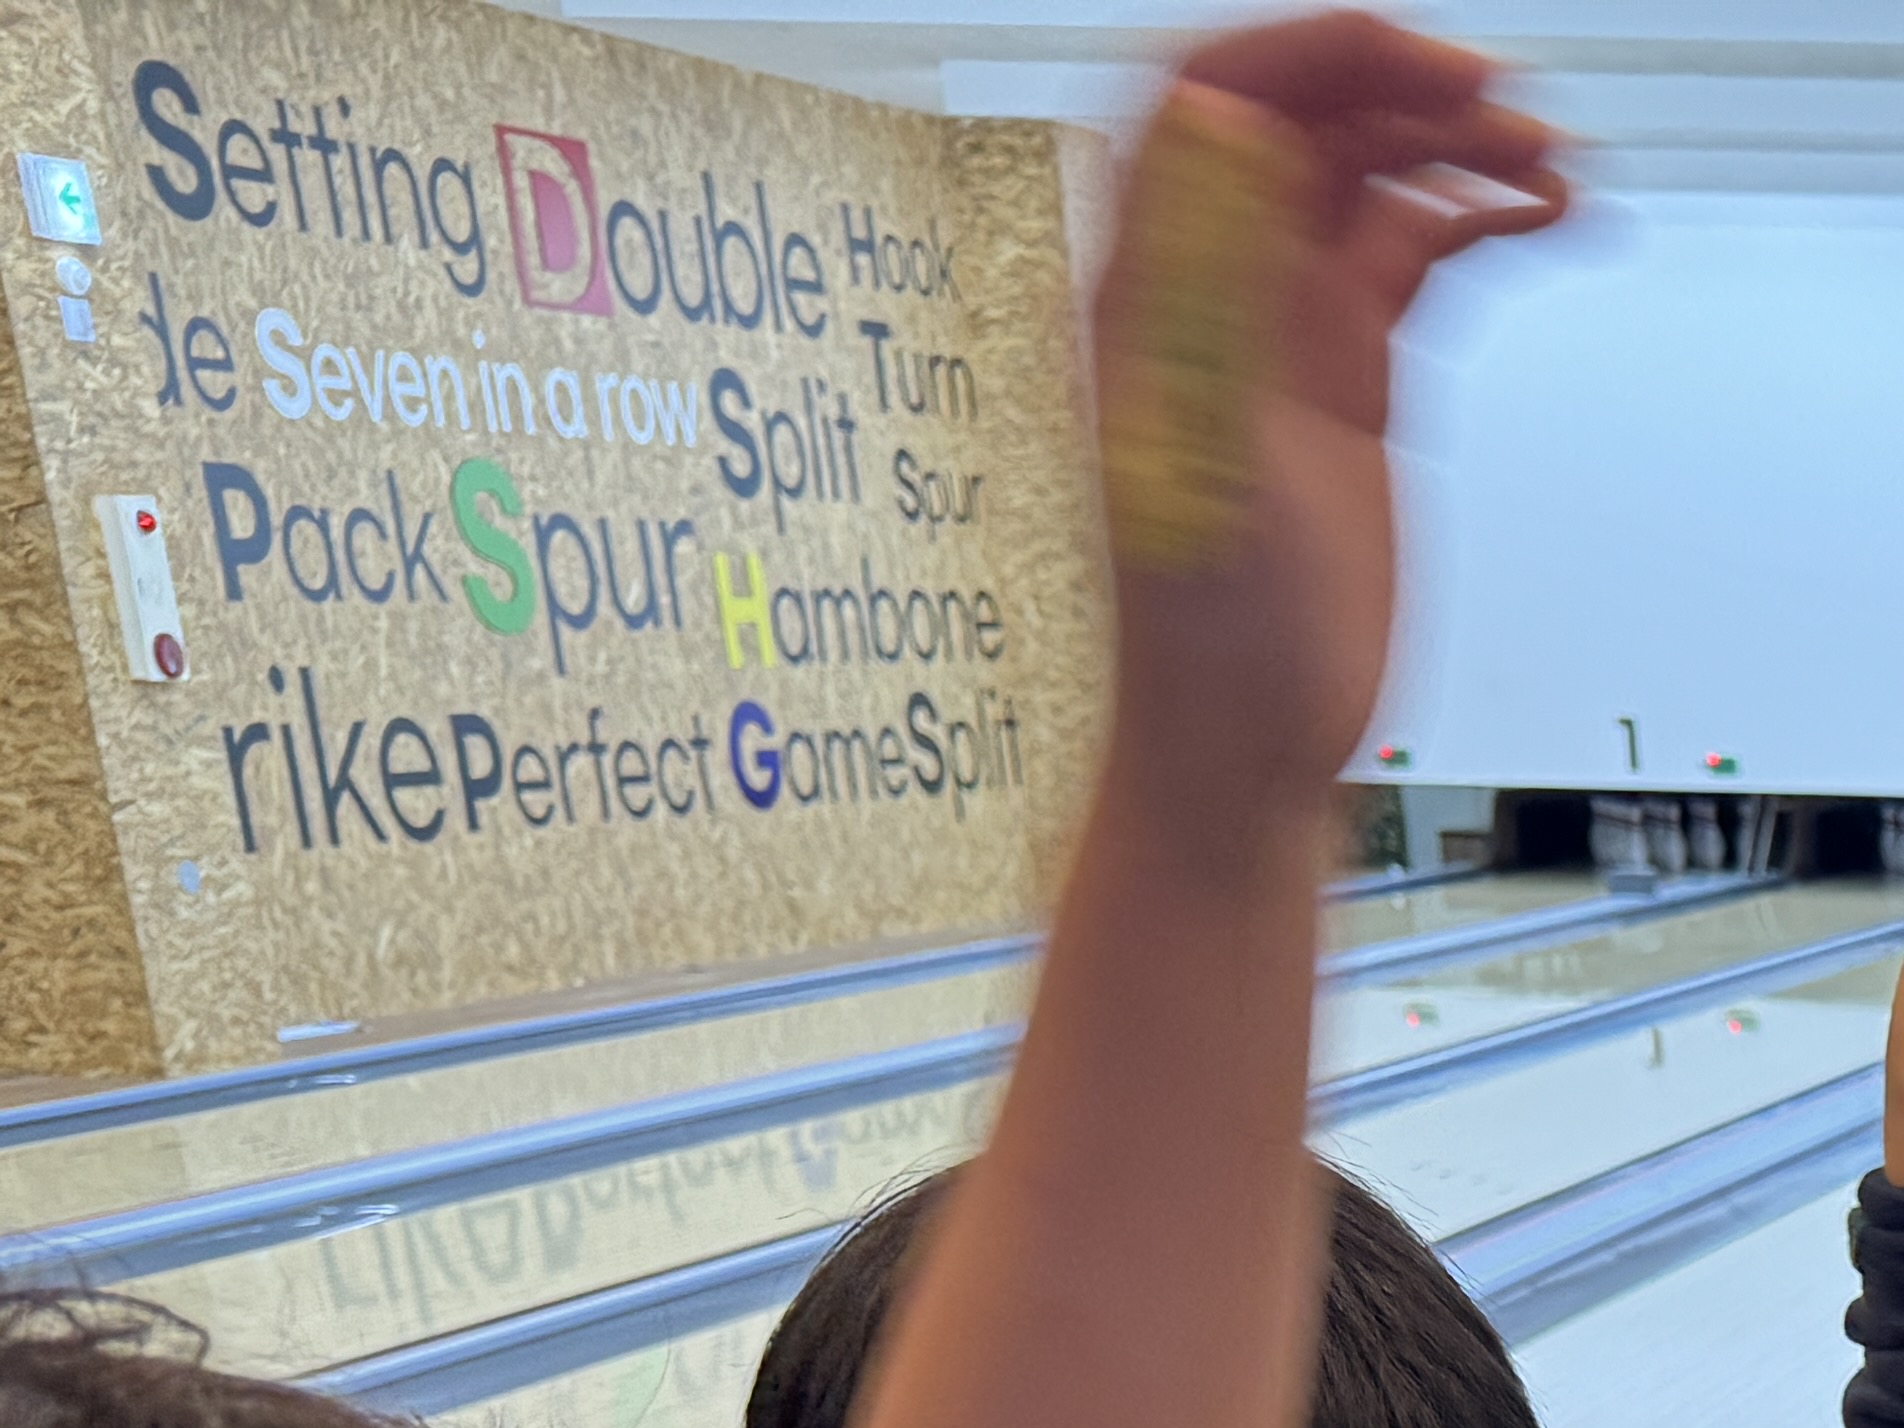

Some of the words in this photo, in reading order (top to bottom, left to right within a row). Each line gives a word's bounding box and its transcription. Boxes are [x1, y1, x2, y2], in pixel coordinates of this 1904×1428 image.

[131, 59, 486, 298] Setting
[494, 122, 829, 337] Double
[841, 200, 958, 302] Hook
[255, 307, 468, 431] Seven
[473, 330, 535, 435] in
[544, 366, 592, 441] a
[598, 366, 698, 447] row
[857, 322, 978, 419] Turn
[710, 366, 860, 539] Split
[892, 448, 984, 541] Spur
[202, 459, 448, 607] Pack
[450, 455, 694, 675] Spur
[712, 551, 1003, 670] Hambone
[220, 664, 445, 853] rike
[448, 703, 716, 832] Perfect
[729, 698, 908, 811] Game
[908, 689, 1027, 825] Split
[1618, 717, 1639, 771] 1
